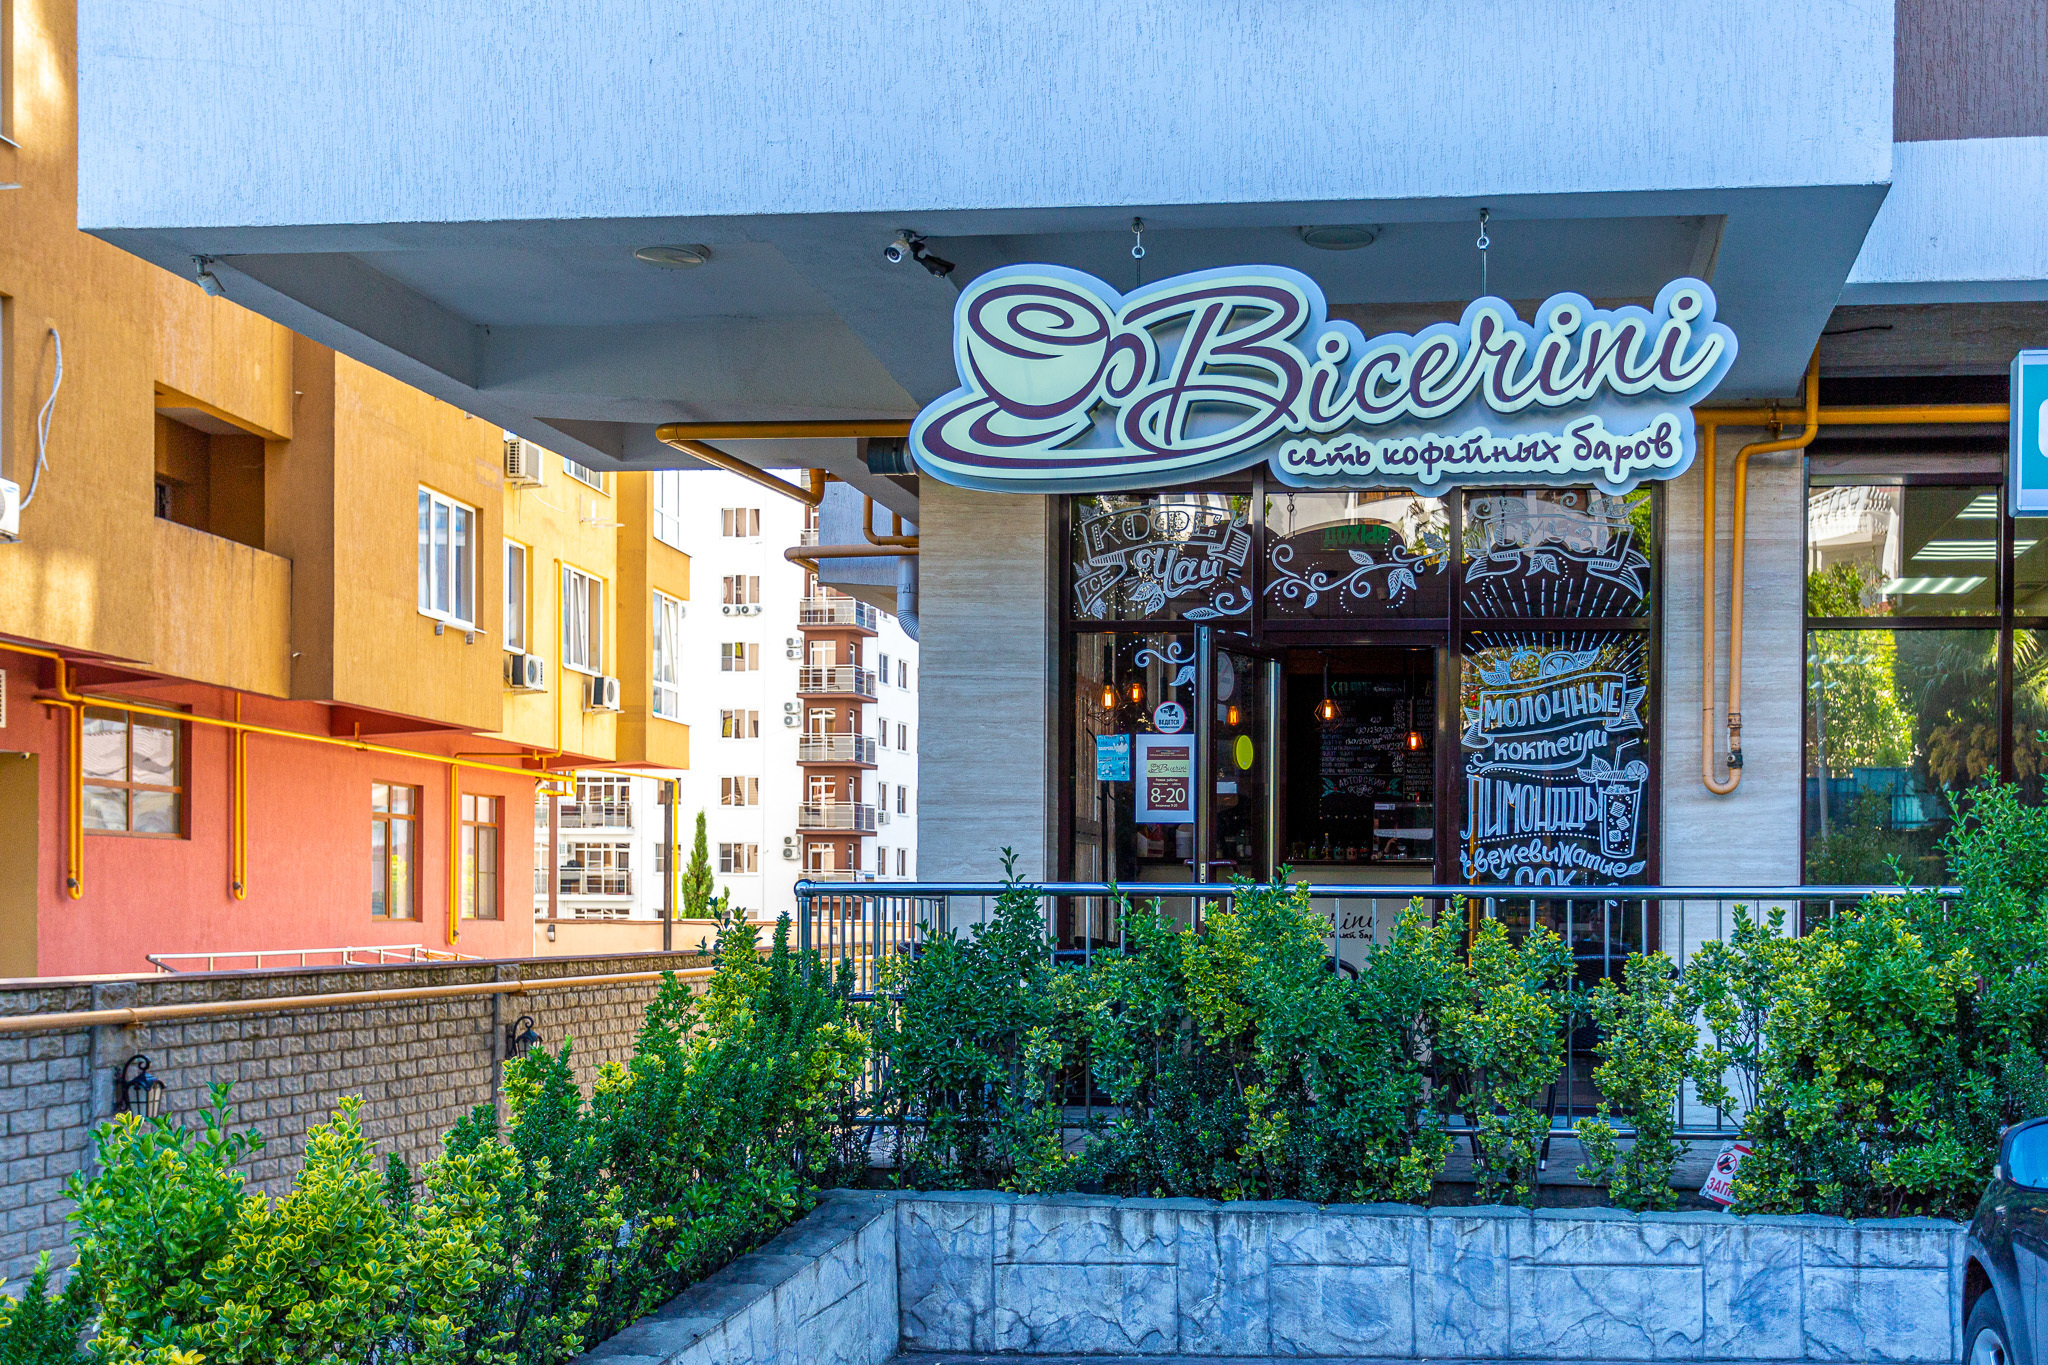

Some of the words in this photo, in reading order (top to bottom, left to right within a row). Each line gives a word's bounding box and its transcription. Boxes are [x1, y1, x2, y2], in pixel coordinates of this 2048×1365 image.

[1123, 285, 1716, 450] Bicerini
[1287, 442, 1371, 467] сеть
[1383, 436, 1561, 475] кофейных
[1573, 422, 1673, 474] баров
[1092, 510, 1223, 551] КОФЕ
[1494, 520, 1620, 556] СМУЗИ
[1080, 570, 1114, 601] ICE
[1133, 547, 1223, 598] Чай
[1484, 682, 1624, 728] МОЛОЧНЫЕ
[1494, 729, 1608, 760] коктейли
[1151, 787, 1186, 803] 8-20
[1460, 774, 1604, 840] ЛИМОНАДЫ
